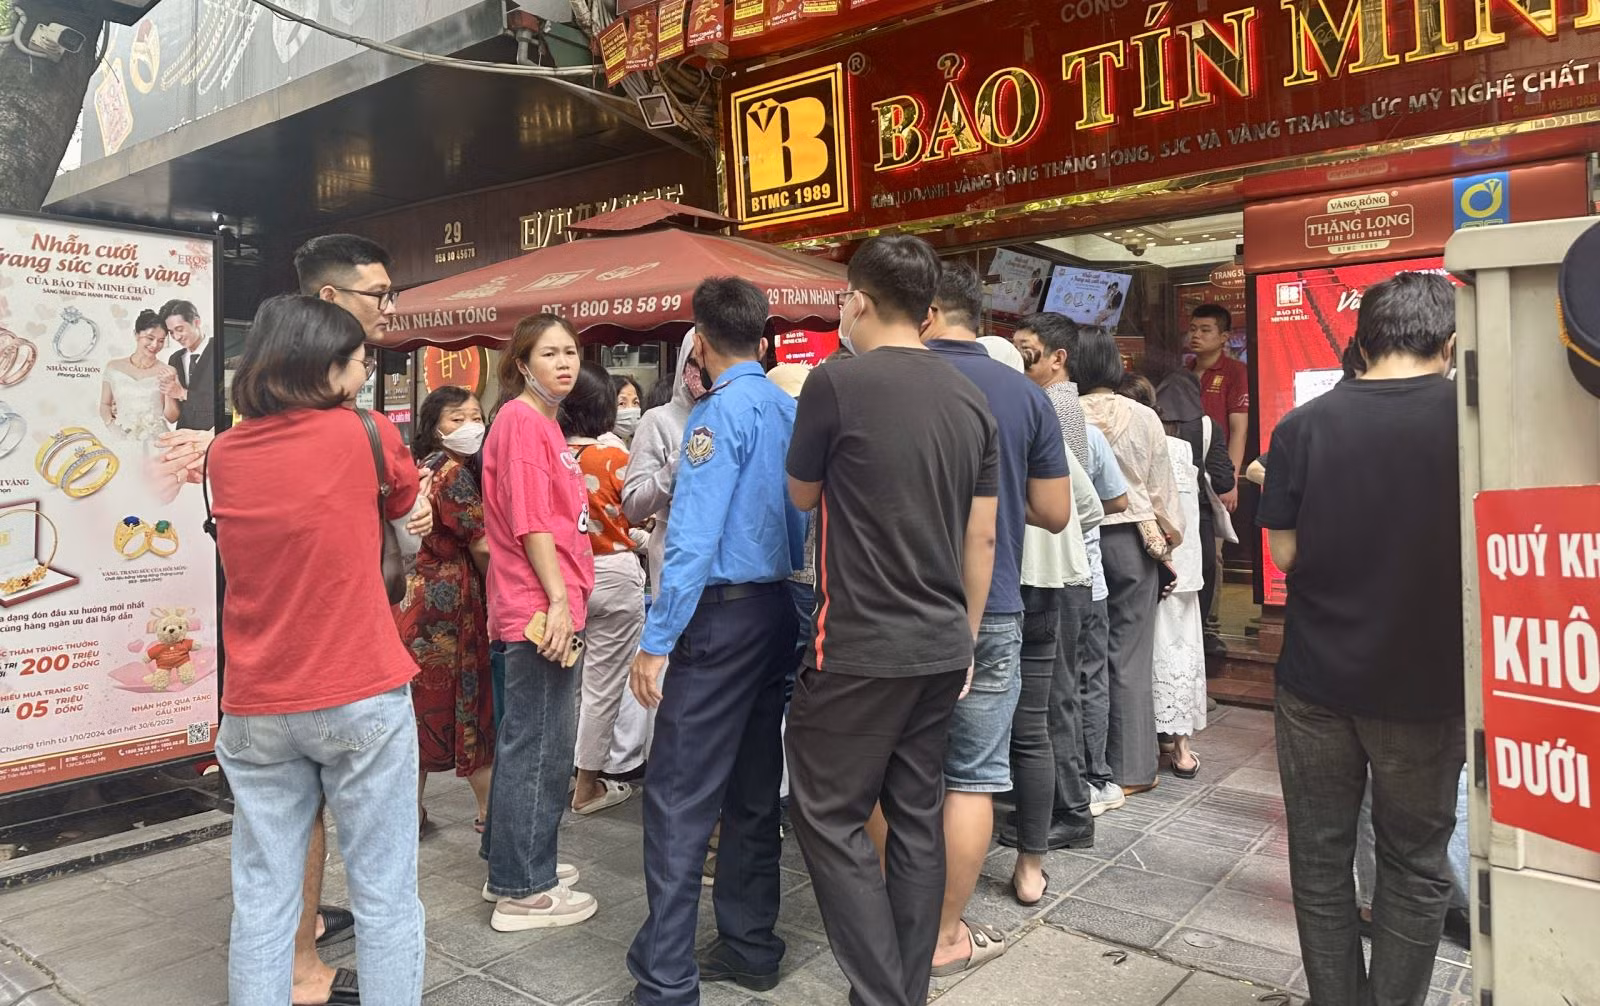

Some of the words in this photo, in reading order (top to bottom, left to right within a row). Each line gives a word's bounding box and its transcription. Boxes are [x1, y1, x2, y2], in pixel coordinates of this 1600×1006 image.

[872, 53, 1043, 172] BẢO
[1062, 1, 1256, 130] TÍN
[954, 172, 992, 194] VÀNG
[1042, 154, 1098, 178] THĂNG
[1160, 136, 1192, 158] SJC
[1197, 128, 1222, 150] VÀ
[1228, 120, 1281, 145] VÀNG
[1285, 107, 1355, 136] TRANG
[1359, 96, 1402, 122] SỨC
[1408, 87, 1442, 114] MỸ
[1450, 73, 1516, 107] NGHỆ
[1522, 59, 1590, 93] CHẤT
[752, 191, 790, 212] BTMC
[794, 183, 831, 204] 1989
[1330, 199, 1358, 211] VÀNG
[1360, 194, 1386, 206] RỒNG
[444, 221, 462, 244] 29
[1308, 219, 1362, 236] THĂNG
[1366, 213, 1410, 230] LONG
[31, 233, 91, 256] Nhẫn
[95, 243, 138, 261] cưới
[1328, 234, 1344, 242] FINE
[1347, 232, 1365, 240] GOLD
[56, 256, 92, 274] sức
[96, 261, 140, 278] cưới
[144, 264, 192, 286] vàng
[178, 254, 208, 266] EROS
[26, 275, 49, 286] CỦA
[52, 278, 74, 288] BẢO
[76, 280, 95, 290] TÍN
[98, 283, 125, 293] MINH
[128, 285, 156, 296] CHÂU
[1214, 270, 1236, 280] TRANG
[766, 288, 780, 304] 29
[781, 284, 808, 304] TRẦN
[809, 288, 836, 304] NHÂN
[413, 308, 454, 329] NHÂN
[456, 306, 497, 325] TÔNG
[572, 300, 609, 318] 1800
[612, 298, 632, 315] 58
[636, 296, 658, 313] 58
[661, 294, 682, 312] 99
[1486, 524, 1548, 580] QUÝ
[0, 624, 21, 633] cùng
[24, 621, 46, 631] hàng
[48, 619, 70, 629] ngàn
[101, 613, 116, 623] hấp
[118, 612, 133, 620] dẫn
[8, 613, 29, 623] dạng
[32, 610, 48, 619] đón
[50, 608, 67, 617] đầu
[126, 600, 145, 610] nhất
[20, 654, 70, 676] 200
[72, 650, 100, 660] TRIỆU
[72, 659, 100, 669] ĐỒNG
[0, 694, 20, 702] HIẾU
[22, 690, 42, 698] MUA
[44, 686, 72, 696] TRANG
[74, 683, 90, 692] SỨC
[16, 700, 50, 720] 05
[55, 694, 83, 704] TRIỆU
[174, 706, 192, 714] XINH
[36, 738, 57, 748] trình
[1494, 737, 1591, 809] DƯỚI
